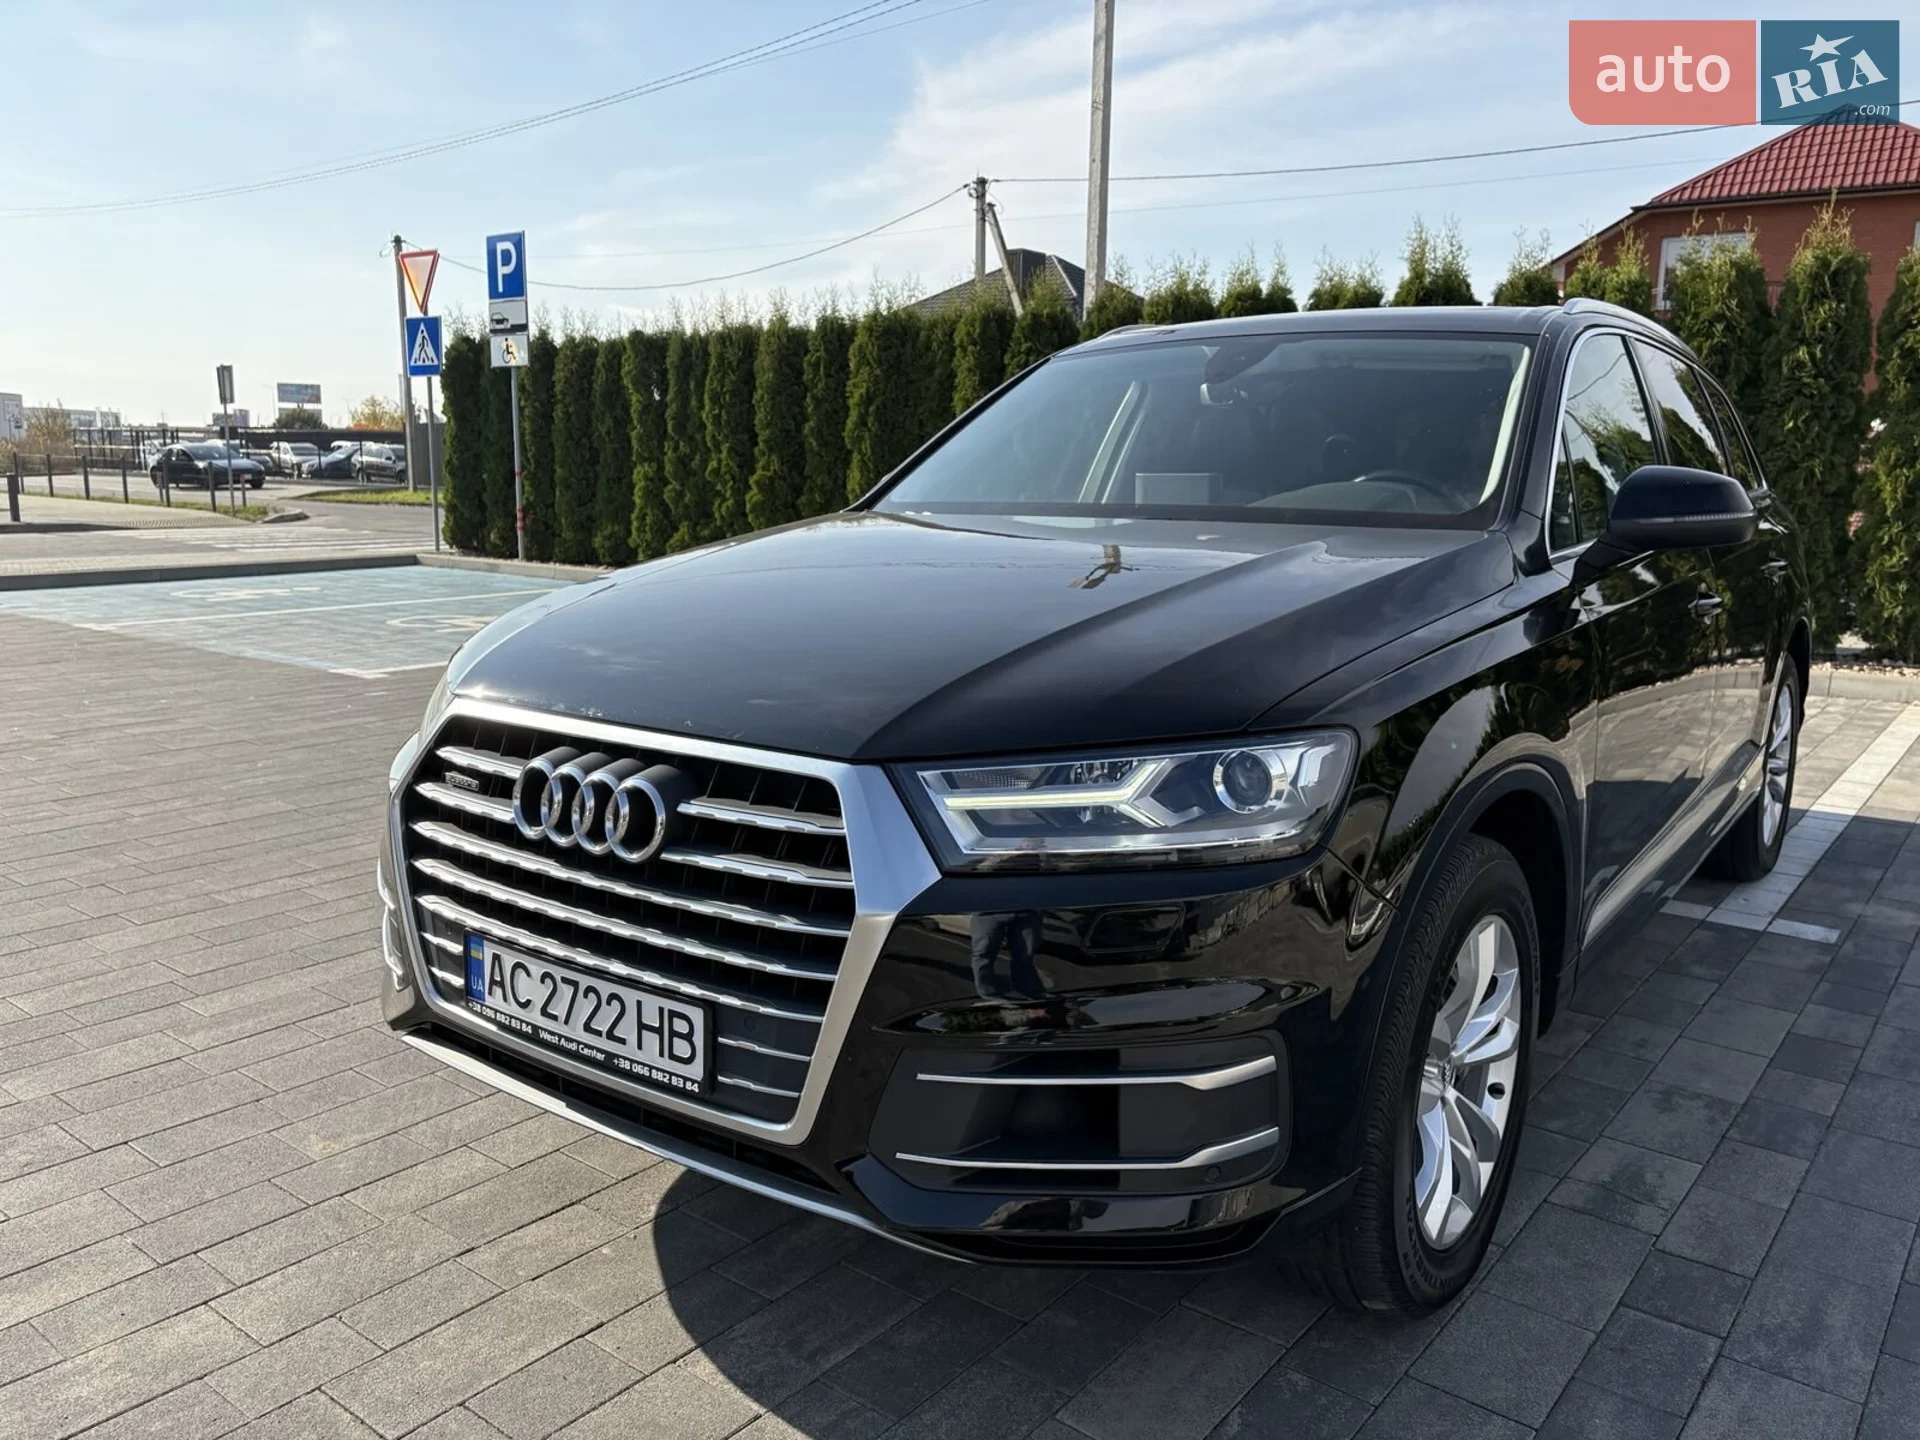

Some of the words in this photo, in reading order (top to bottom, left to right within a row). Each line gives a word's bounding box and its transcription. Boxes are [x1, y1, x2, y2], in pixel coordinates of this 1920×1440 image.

[496, 241, 517, 293] P
[471, 975, 484, 992] UA
[538, 1028, 559, 1045] West
[560, 1037, 578, 1051] Audi
[579, 1044, 606, 1062] Center
[612, 1056, 631, 1070] +38
[632, 1063, 650, 1077] 066
[651, 1069, 670, 1084] 882
[671, 1076, 684, 1089] 83
[685, 1081, 700, 1093] 84
